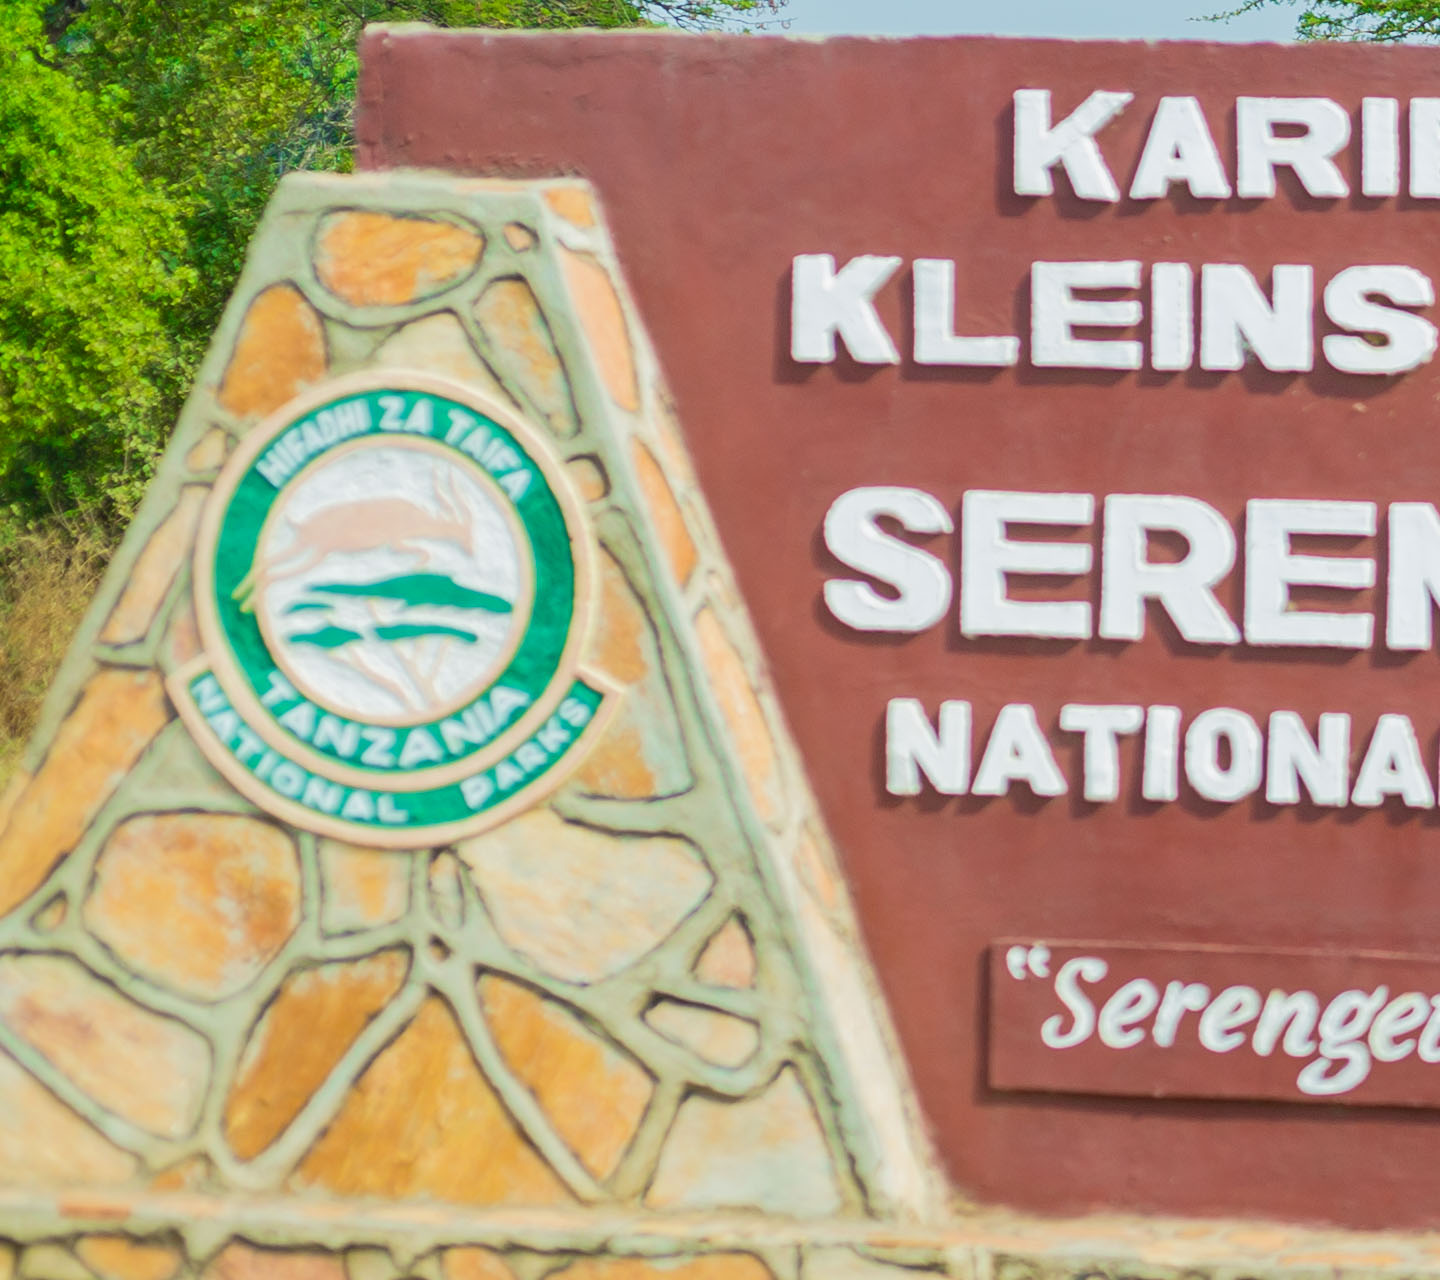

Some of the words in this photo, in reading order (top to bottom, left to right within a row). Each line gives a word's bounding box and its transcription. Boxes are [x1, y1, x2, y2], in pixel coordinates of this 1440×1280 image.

[790, 253, 1438, 376] KLEINS
[256, 397, 372, 490] HIFADHI
[378, 395, 434, 434] ZA
[445, 408, 532, 504] TAIFA
[190, 671, 408, 824] NATIONAL
[460, 696, 592, 810] PARKS
[261, 671, 530, 769] TANZANIA
